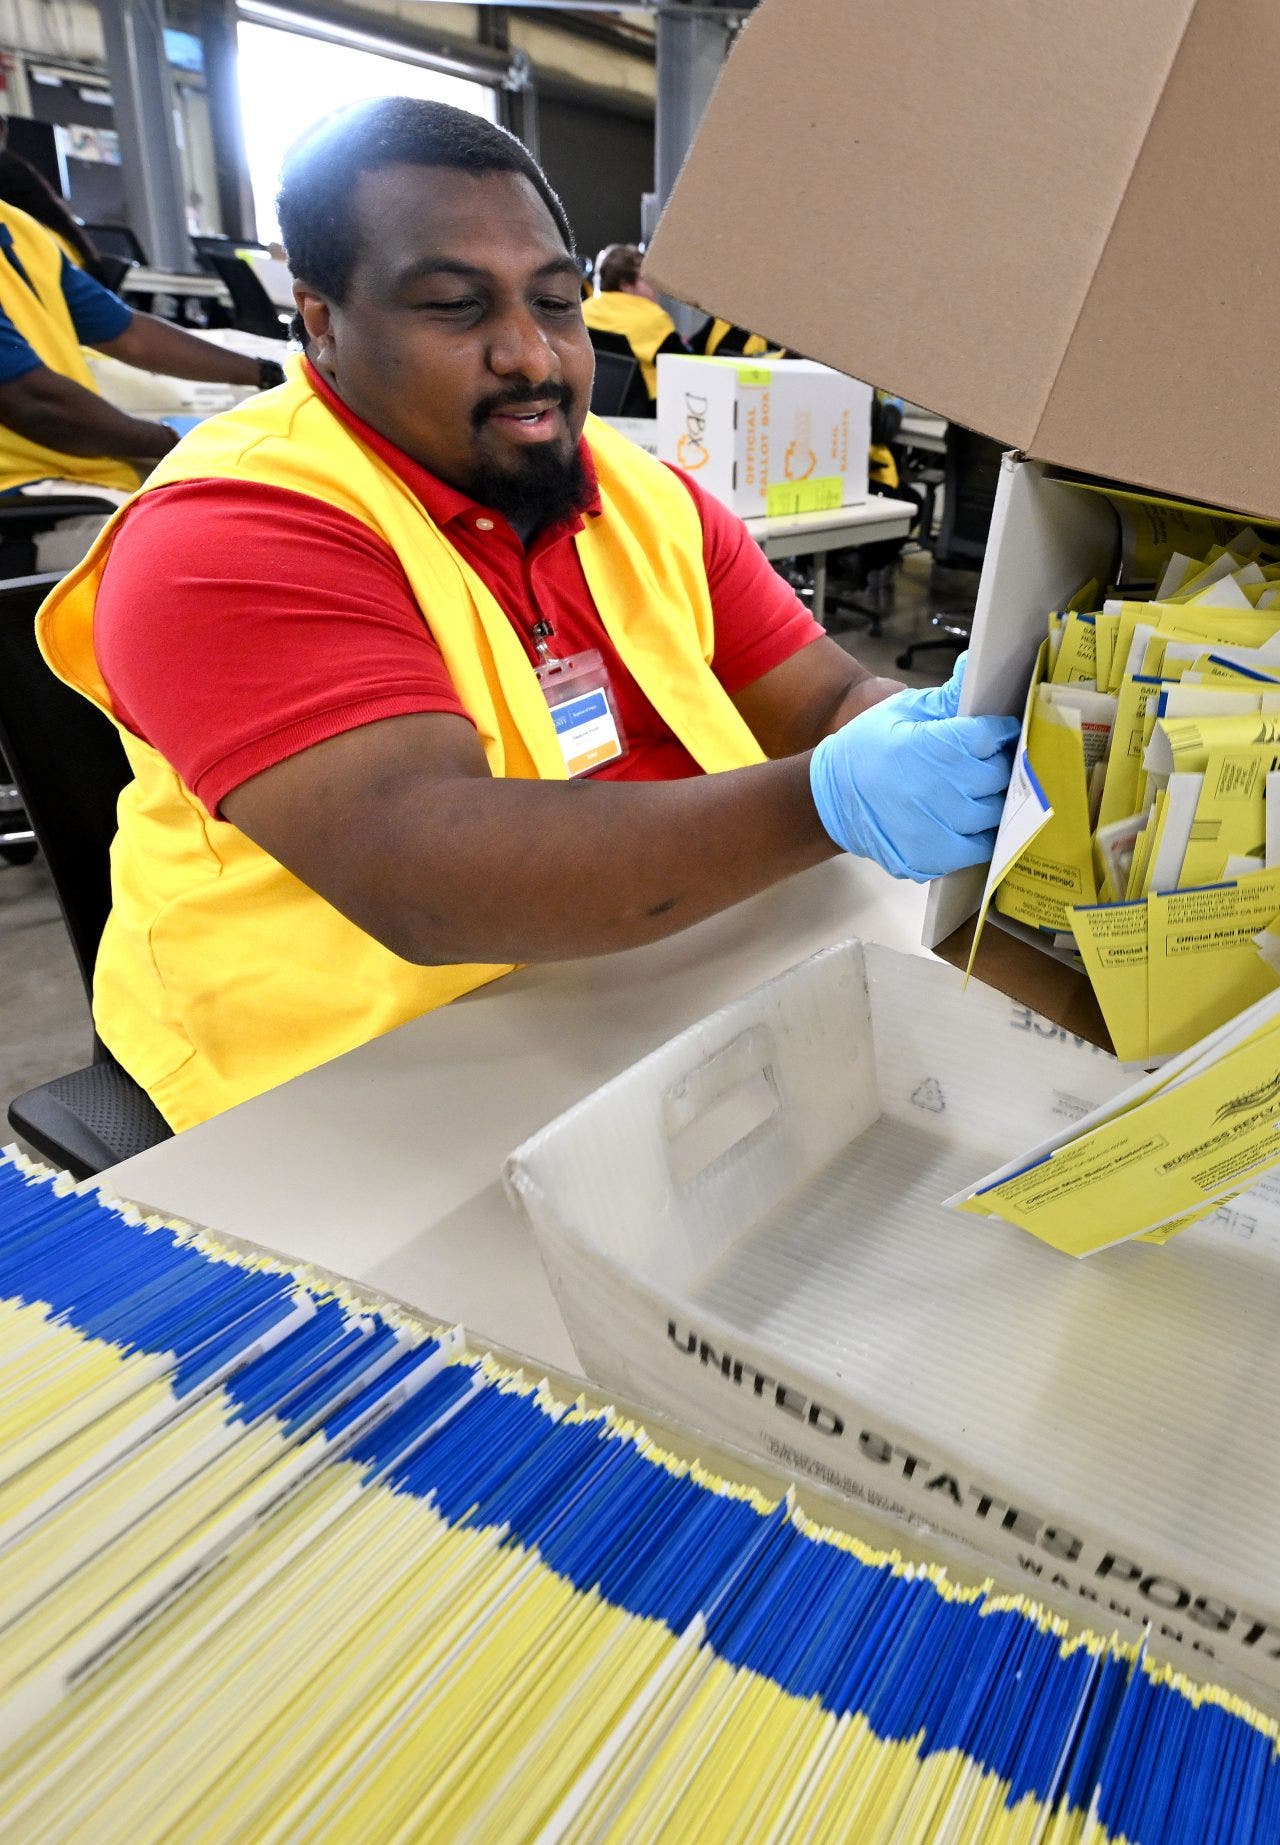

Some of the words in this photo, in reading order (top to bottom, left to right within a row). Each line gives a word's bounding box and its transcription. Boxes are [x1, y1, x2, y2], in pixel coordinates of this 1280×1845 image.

[760, 392, 772, 427] BOX
[746, 405, 757, 486] OFFICIAL
[760, 434, 772, 499] BALLOT
[1031, 868, 1048, 880] Mail
[1047, 874, 1075, 888] Official
[1187, 889, 1239, 902] BERNARDINO
[1242, 884, 1275, 896] COUNTY
[1108, 947, 1143, 956] Official
[1177, 934, 1211, 944] Official
[1214, 929, 1235, 939] Mail
[1163, 1131, 1230, 1171] BUSINESS
[1232, 1105, 1275, 1133] REPLY
[667, 1320, 845, 1437] UNITED
[859, 1429, 1084, 1563] STATES
[1016, 1554, 1217, 1659] WARNING
